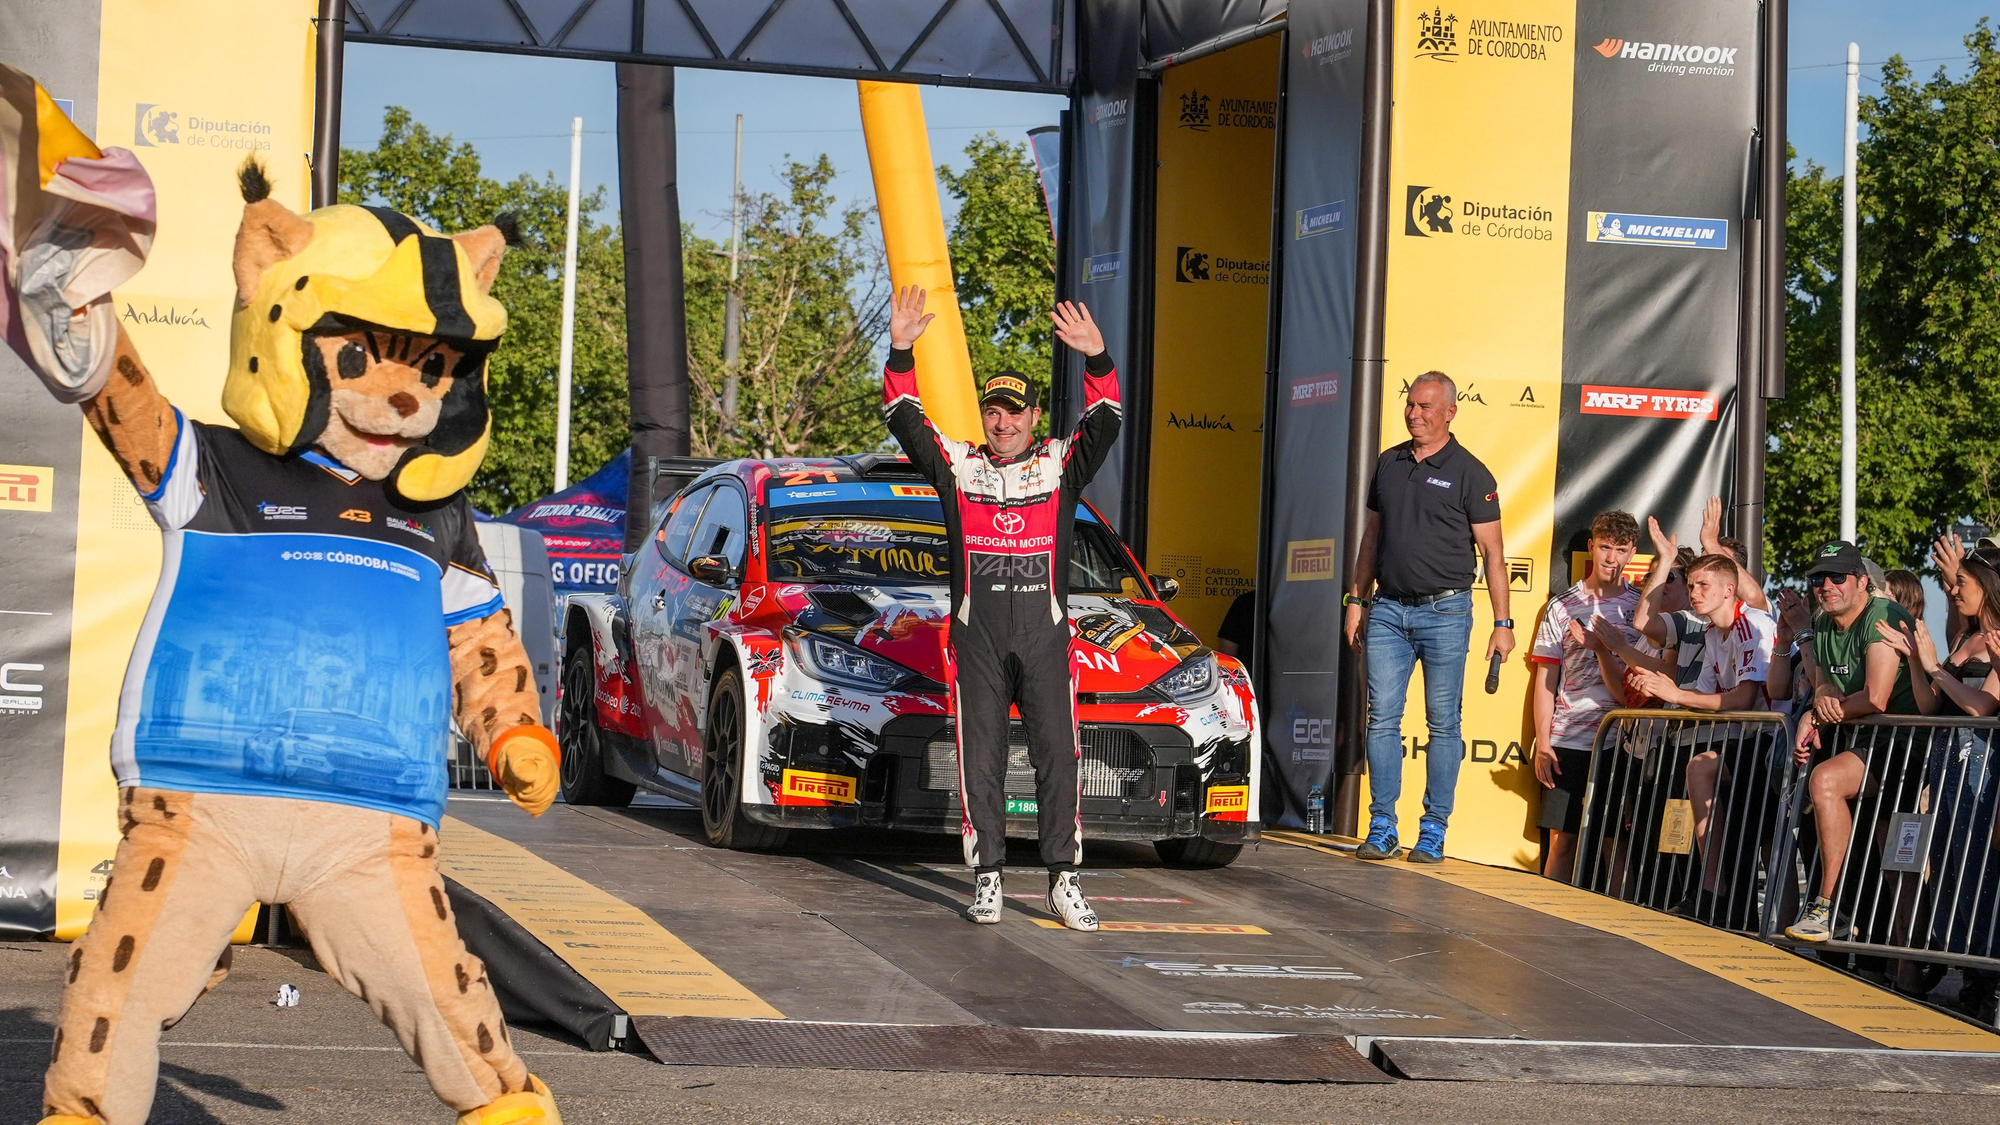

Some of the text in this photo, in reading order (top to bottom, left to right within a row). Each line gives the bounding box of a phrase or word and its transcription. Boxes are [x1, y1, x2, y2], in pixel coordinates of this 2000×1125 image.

[1468, 19, 1562, 43] AYUNTAMIENTO
[1468, 38, 1546, 60] DE CORDOBA
[1648, 62, 1735, 77] driving emotion
[189, 117, 271, 135] Diputación
[1218, 113, 1230, 126] DE
[187, 134, 271, 151] de Córdoba
[1463, 201, 1552, 222] Diputación
[1461, 221, 1552, 241] de Córdoba
[1626, 224, 1716, 240] MICHELIN
[1216, 257, 1270, 271] Diputació
[1215, 273, 1229, 282] de
[122, 303, 212, 329] Andalucía
[1293, 380, 1338, 400] MRF TYRES
[1585, 392, 1714, 414] MRF TYRES
[1167, 411, 1236, 433] Andalucía
[339, 509, 371, 523] 43
[966, 535, 1054, 548] BREOGÁN MOTOR
[326, 551, 389, 571] CÓRDOBA
[1292, 548, 1331, 578] PIRELLI
[1205, 567, 1240, 576] CABILDO
[1205, 576, 1257, 587] CATEDRAL
[1205, 587, 1218, 596] DE
[1294, 718, 1332, 744] ERC
[790, 774, 850, 798] PIRELLI
[1008, 802, 1015, 811] P
[1210, 791, 1244, 808] PIRELLI
